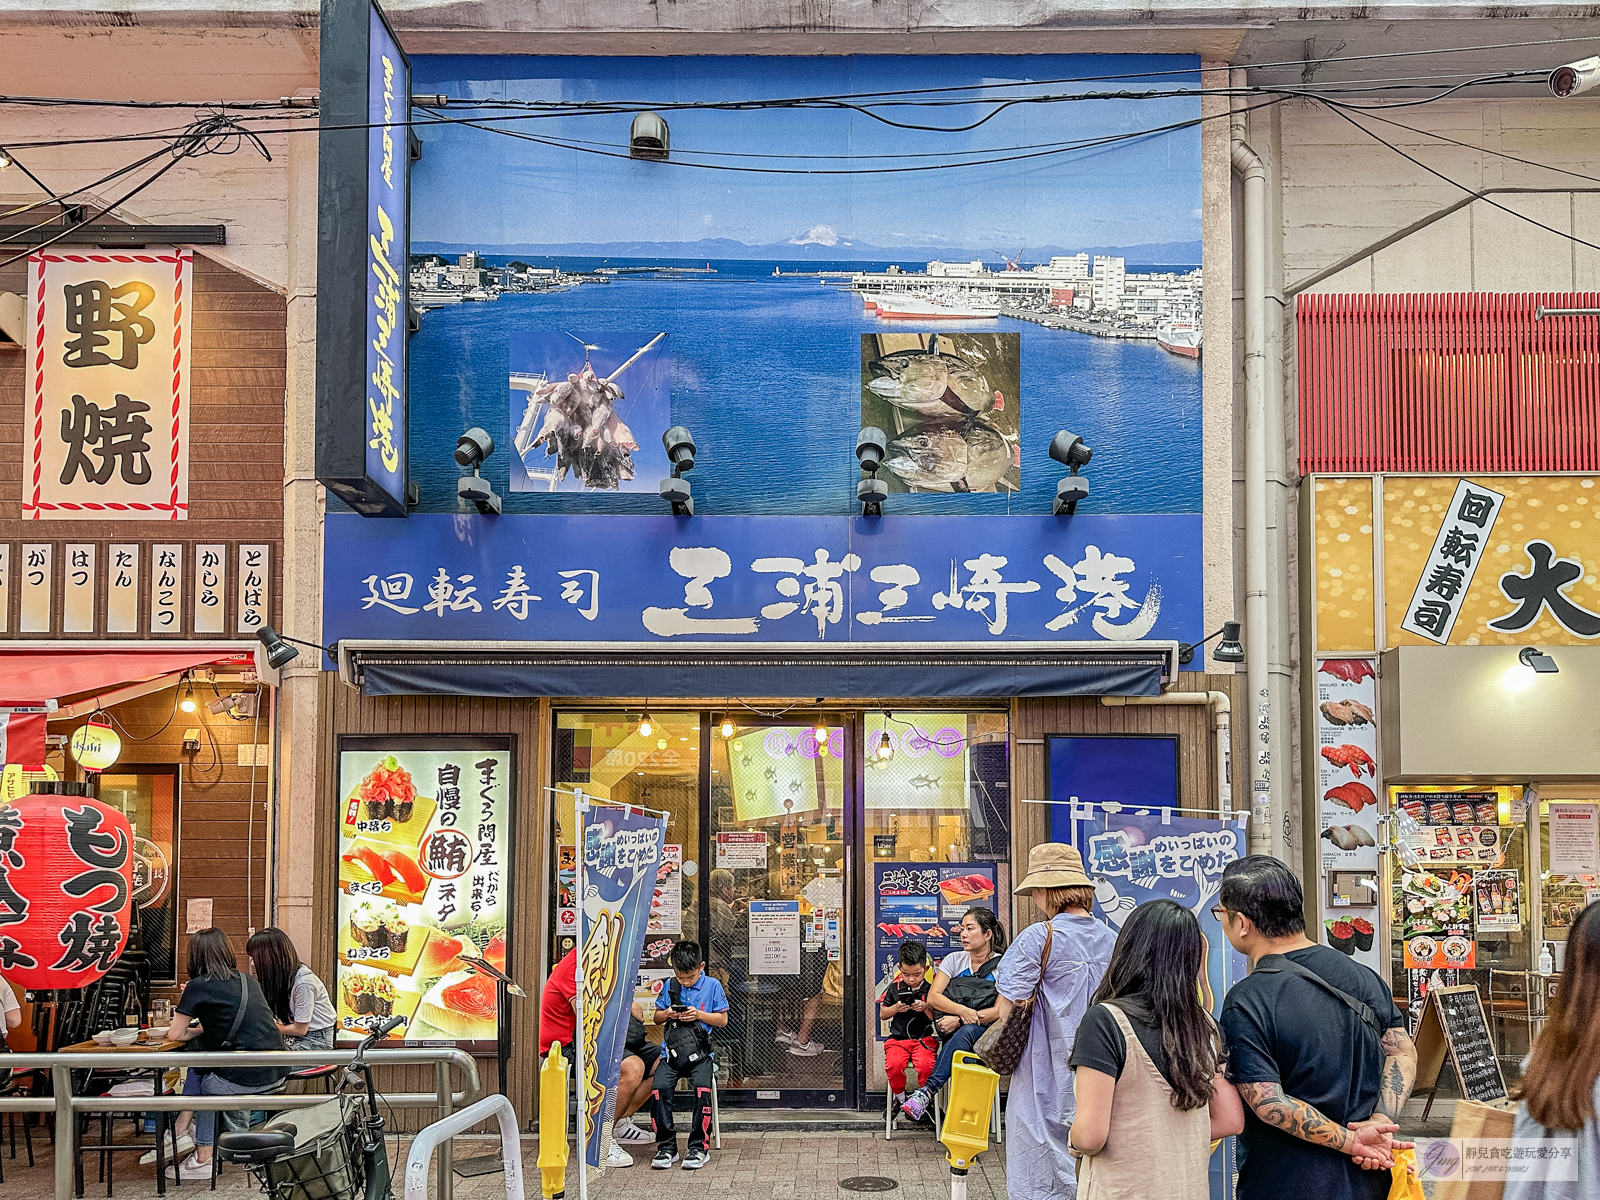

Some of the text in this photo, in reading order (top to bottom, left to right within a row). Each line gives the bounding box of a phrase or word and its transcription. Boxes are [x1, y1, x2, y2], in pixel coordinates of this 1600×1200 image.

[59, 280, 156, 485] 野焼
[28, 549, 46, 586] がつ
[72, 550, 89, 586] はつ
[115, 550, 132, 587] たん
[158, 550, 176, 625] なんこつ
[201, 550, 219, 606] かしら
[244, 550, 262, 626] とんばら
[1413, 488, 1495, 638] 回転寿司
[361, 565, 600, 621] 廻転寿司
[642, 545, 1164, 641] 三浦三崎港
[357, 820, 391, 832] 中落ち
[473, 758, 500, 866] まぐろ問屋
[586, 828, 617, 866] 感謝
[781, 832, 797, 889] 営業中
[1093, 836, 1158, 880] 感謝
[49, 805, 129, 972] もつ焼
[350, 882, 382, 893] まぐろ
[485, 870, 500, 906] だから
[879, 867, 941, 894] 三崎まぐろ
[347, 948, 390, 959] ねぎとろ
